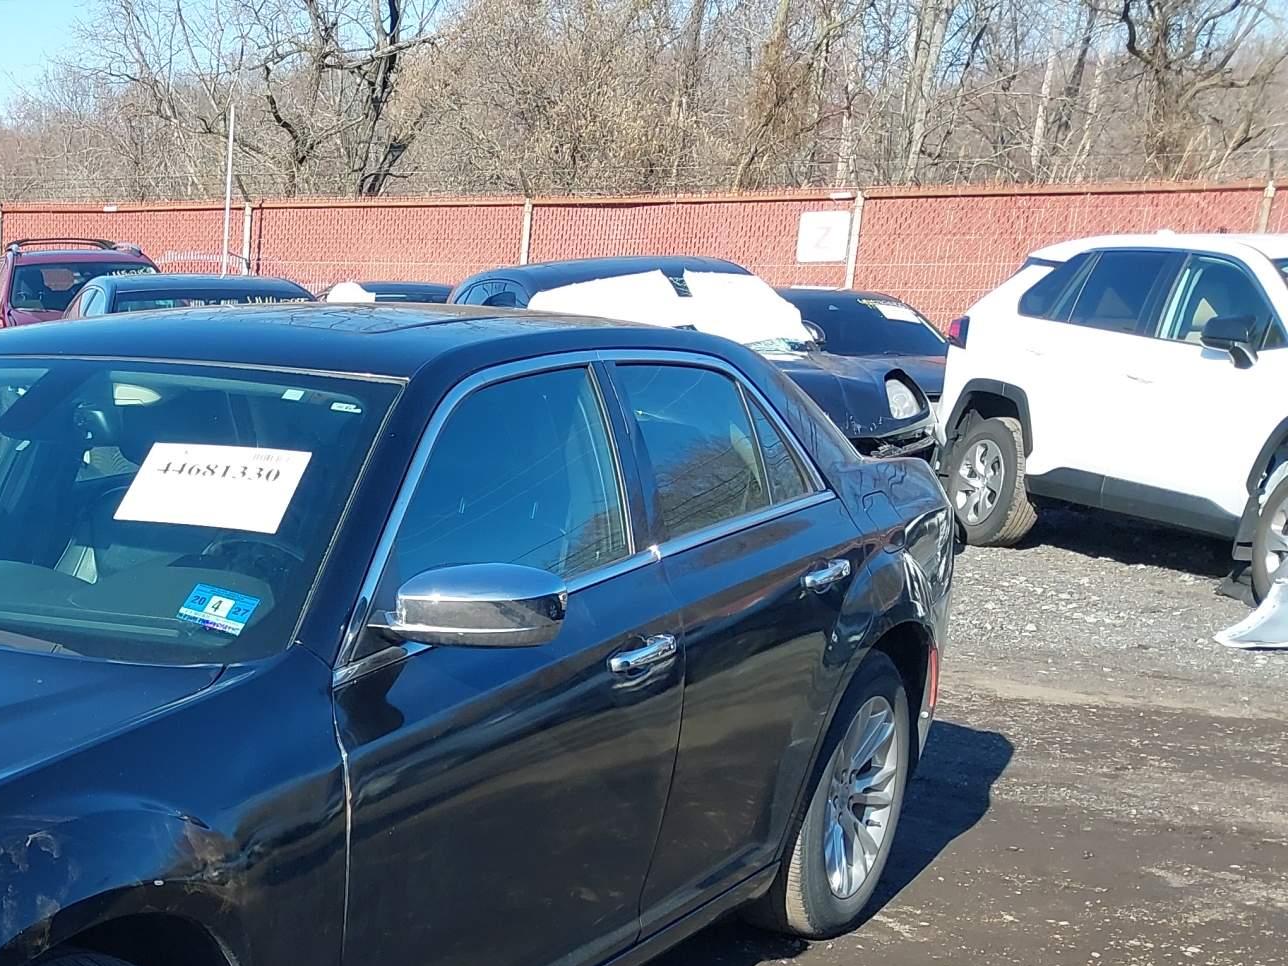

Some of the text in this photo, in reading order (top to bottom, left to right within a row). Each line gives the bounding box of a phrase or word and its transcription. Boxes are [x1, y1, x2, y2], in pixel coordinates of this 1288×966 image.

[158, 462, 280, 482] 44681330
[192, 595, 250, 617] 20 4 27
